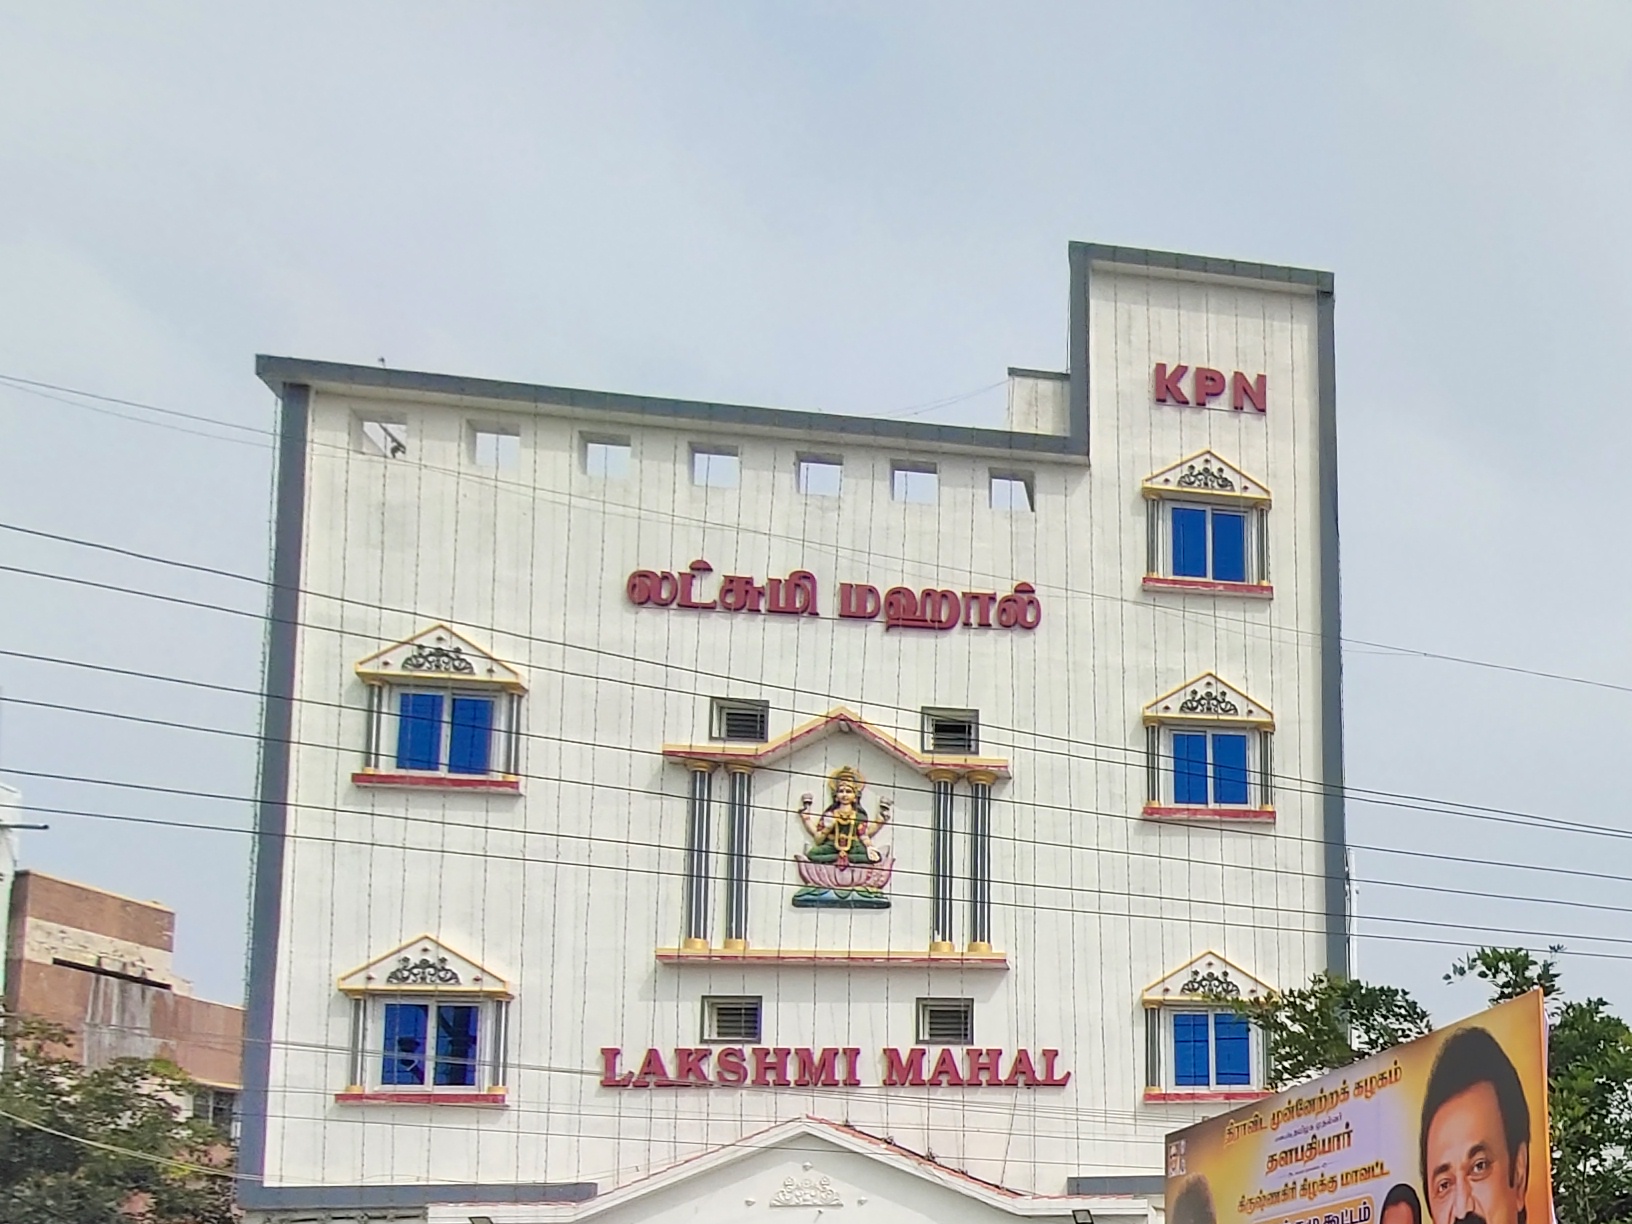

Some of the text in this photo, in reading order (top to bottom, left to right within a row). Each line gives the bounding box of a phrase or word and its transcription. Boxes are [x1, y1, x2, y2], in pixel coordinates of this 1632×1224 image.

[1155, 362, 1268, 415] KPN
[626, 559, 1042, 631] லட்சுமி மஹால்
[601, 1047, 1072, 1088] LAKSHMI MAHAL
[1224, 1113, 1267, 1145] திராவிட
[1353, 1059, 1402, 1098] கழகம்
[1265, 1122, 1353, 1176] தளபதியார்
[1341, 1161, 1390, 1187] மாவட்ட
